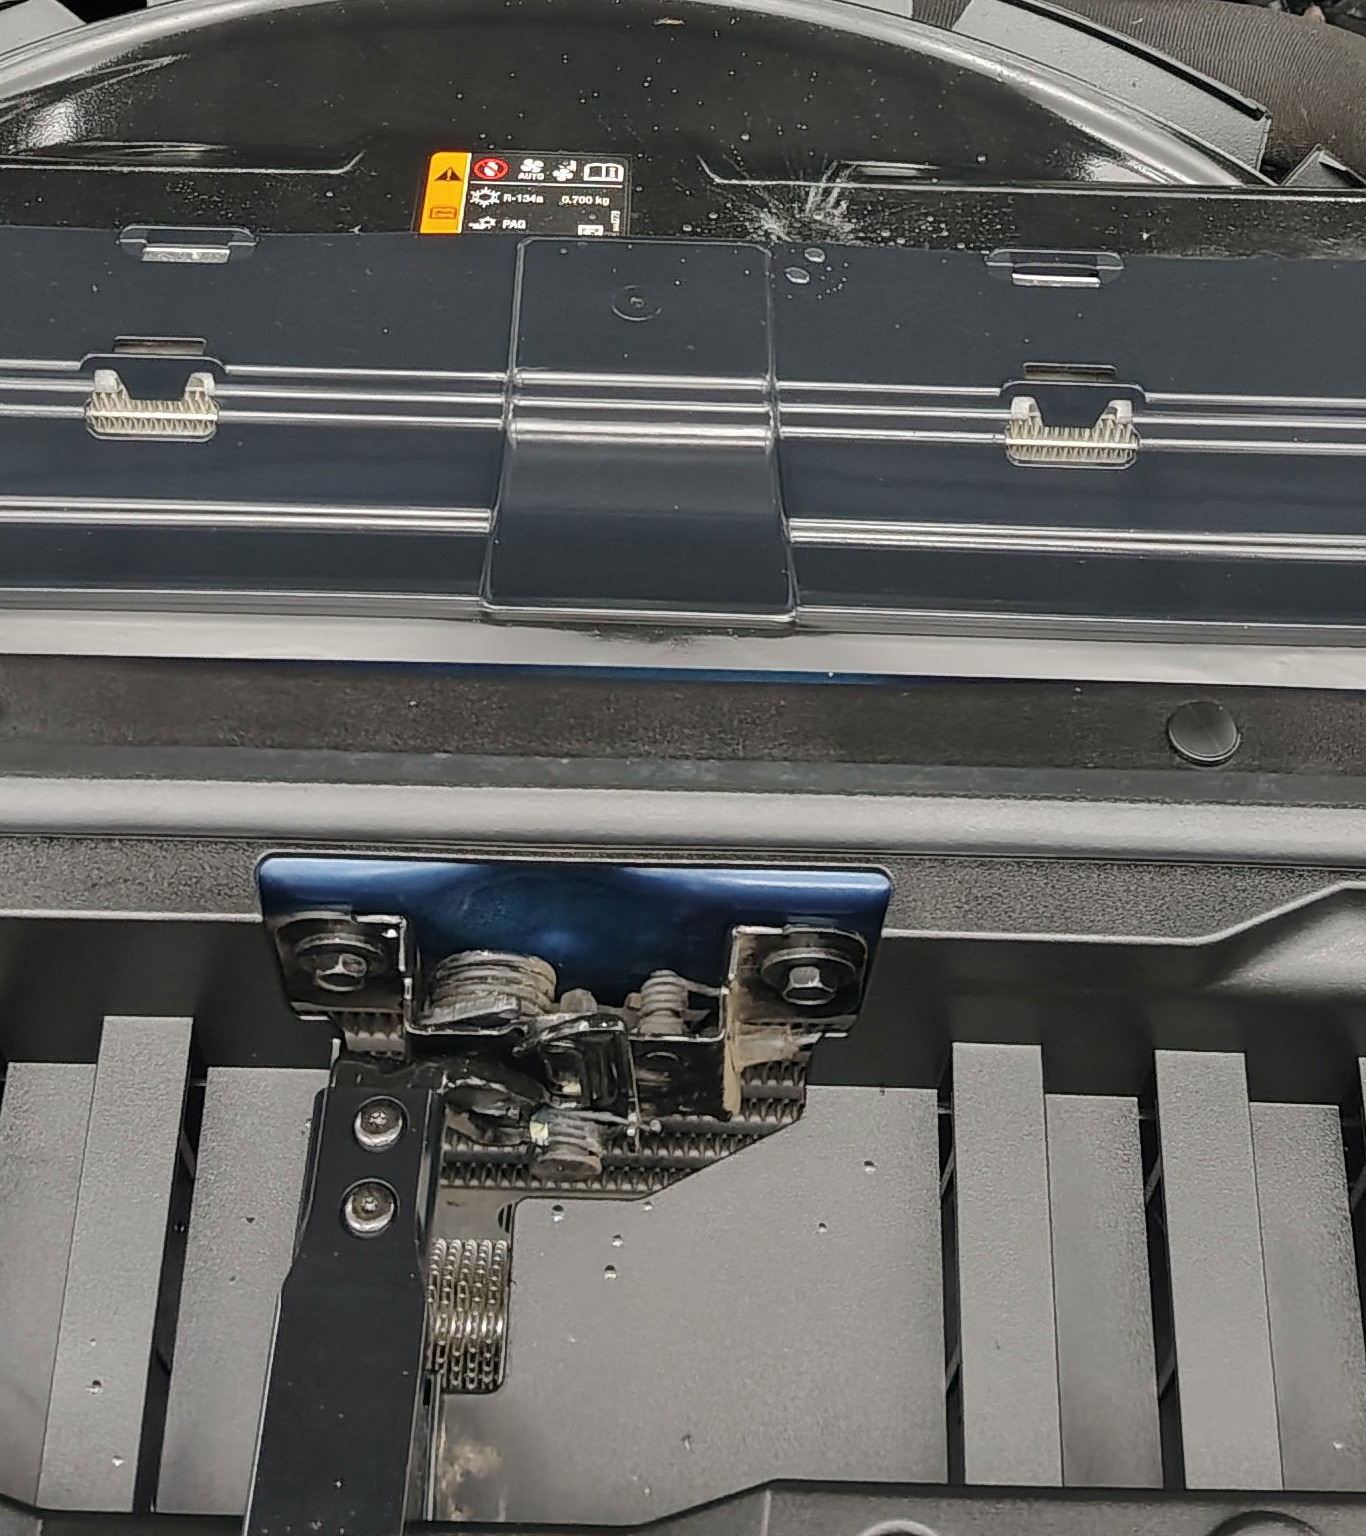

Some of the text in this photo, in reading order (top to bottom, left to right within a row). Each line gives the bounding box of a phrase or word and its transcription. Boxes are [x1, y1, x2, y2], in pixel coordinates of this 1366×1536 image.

[518, 172, 545, 180] AUTO
[503, 193, 544, 204] R-134a
[595, 195, 610, 206] kg
